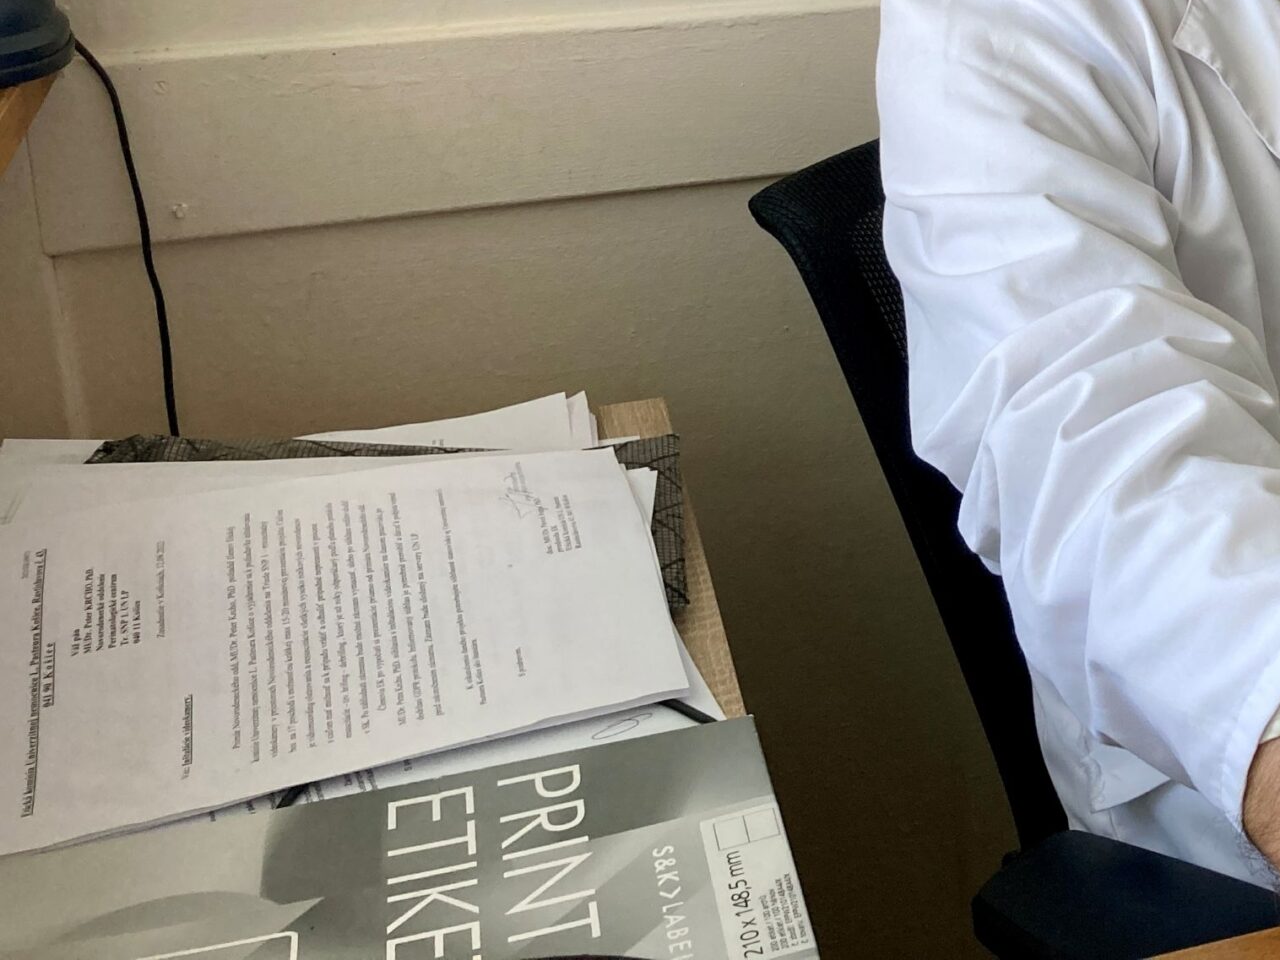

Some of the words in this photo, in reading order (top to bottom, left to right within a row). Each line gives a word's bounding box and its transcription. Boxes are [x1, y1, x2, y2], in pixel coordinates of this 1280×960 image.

[84, 612, 93, 628] Peter
[497, 764, 601, 943] PRINT
[726, 850, 745, 878] mm
[386, 786, 482, 960] ETIKE
[728, 878, 754, 917] 148,5
[741, 916, 758, 928] x
[740, 929, 764, 959] 210
